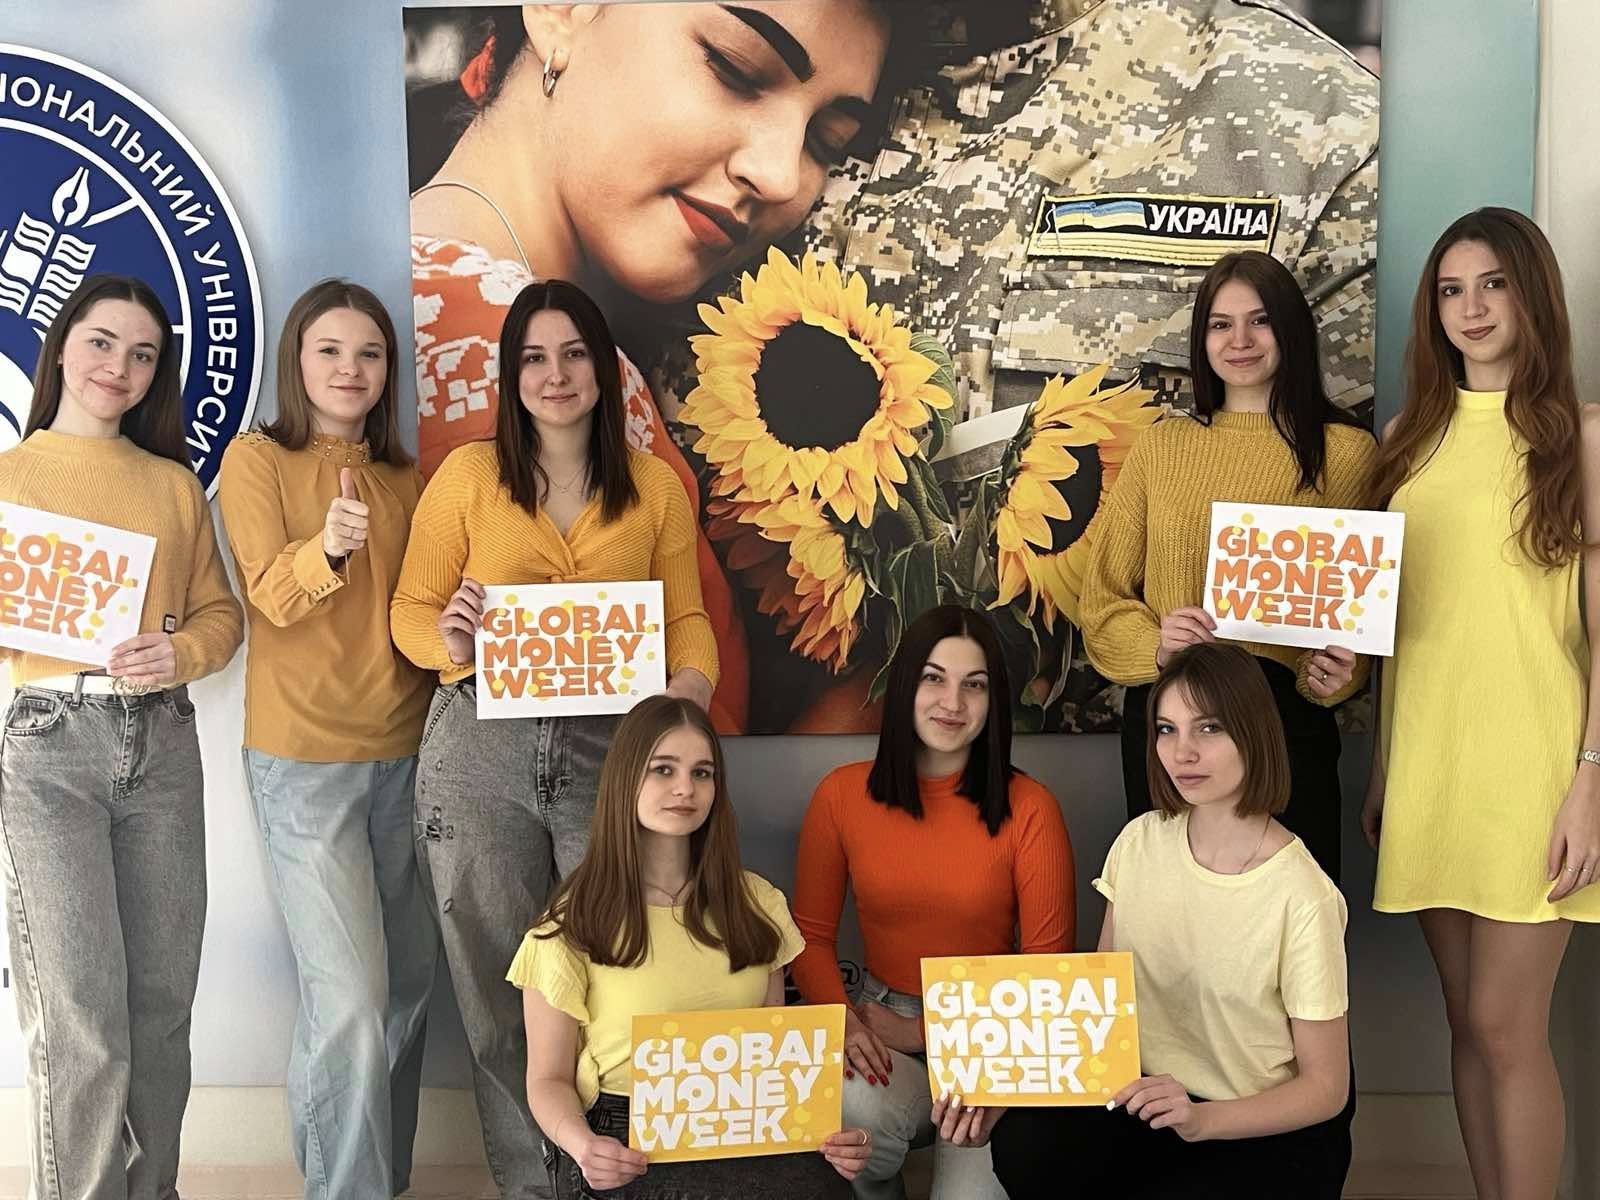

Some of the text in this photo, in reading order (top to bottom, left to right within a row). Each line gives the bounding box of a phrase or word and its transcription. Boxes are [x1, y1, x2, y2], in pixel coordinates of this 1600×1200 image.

[1148, 202, 1268, 236] УКРАЇНА
[1217, 526, 1396, 569] GLOBAL
[1213, 558, 1378, 599] MONEY
[482, 604, 660, 637] GLOBAL
[1211, 588, 1345, 630] WEEK
[483, 634, 643, 668] MONEY
[483, 666, 617, 699] WEEK
[925, 977, 1136, 1019] GLOBAL
[634, 1028, 842, 1077] GLOBAL
[928, 1016, 1116, 1057] MONEY
[633, 1066, 823, 1114] MONEY
[929, 1055, 1087, 1095] WEEK
[631, 1106, 790, 1153] WEEK
